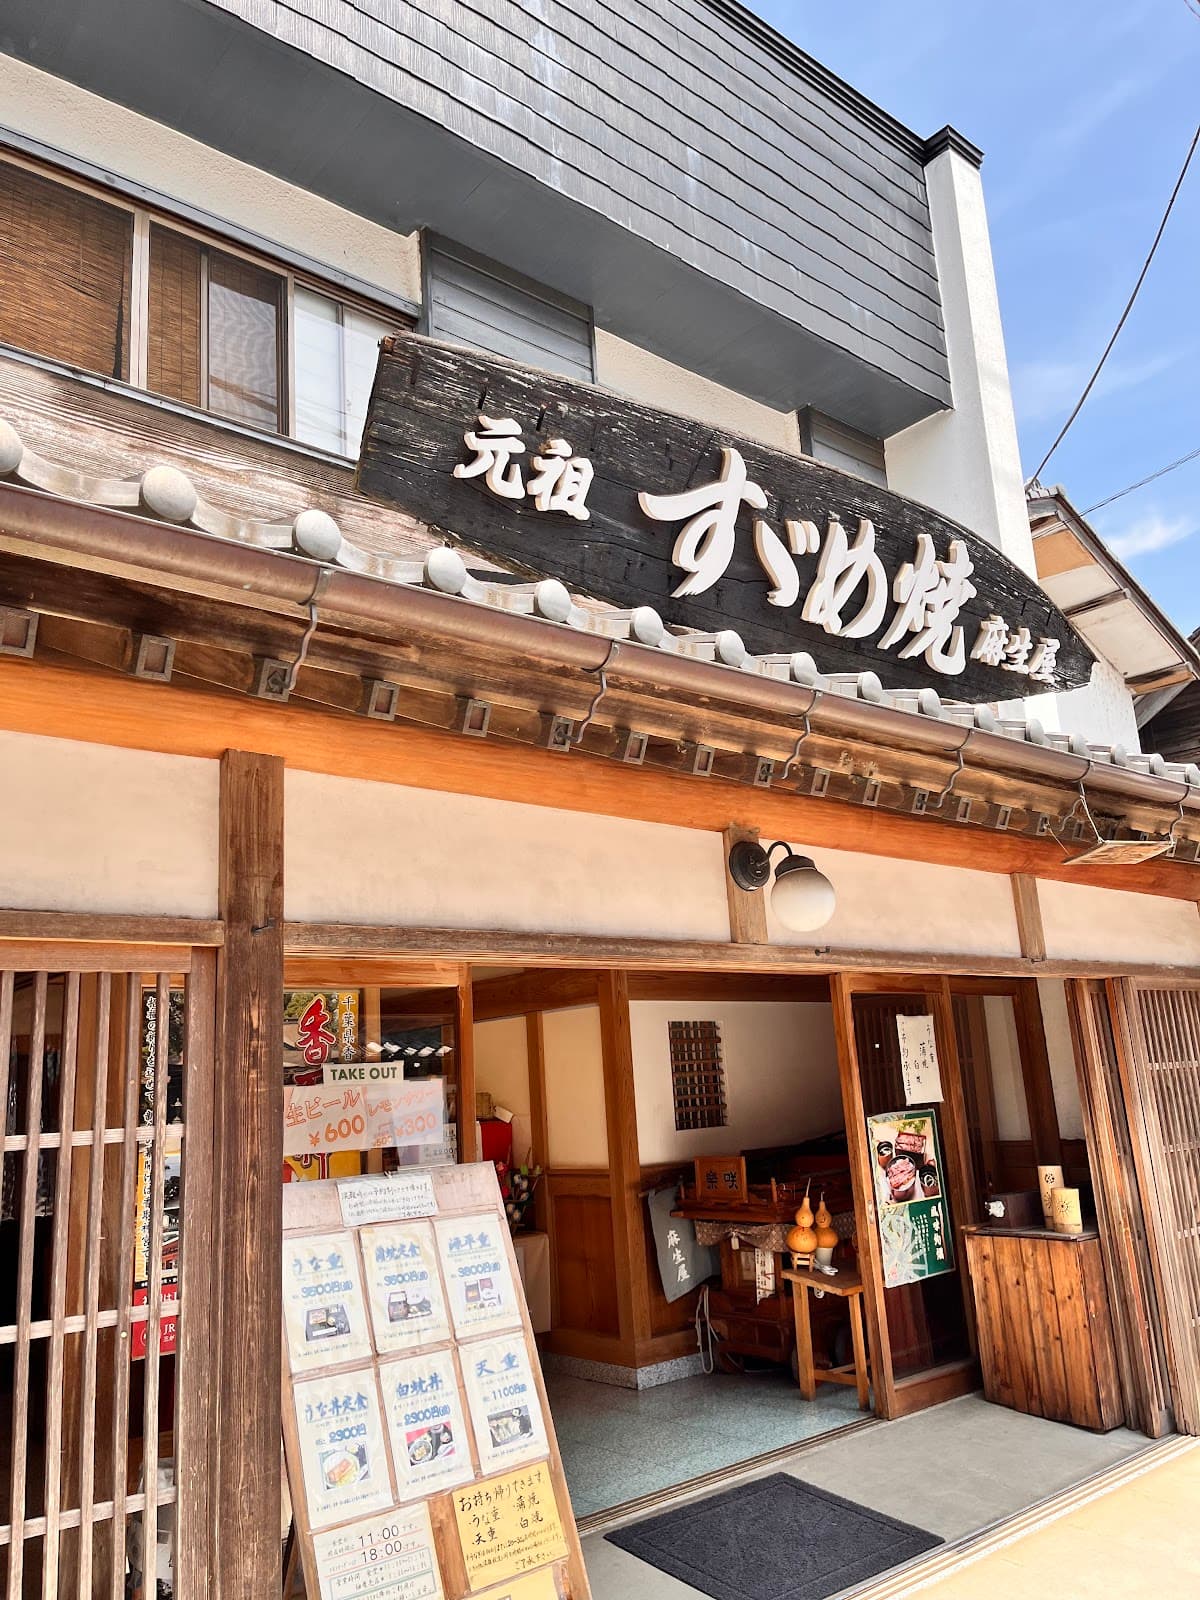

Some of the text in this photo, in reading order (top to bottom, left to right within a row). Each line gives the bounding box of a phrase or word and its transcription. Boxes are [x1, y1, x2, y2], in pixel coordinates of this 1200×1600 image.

[453, 415, 594, 521] 元祖
[970, 614, 1061, 684] 麻生屋
[330, 1068, 365, 1081] TAKE
[369, 1066, 398, 1080] OUT
[286, 1089, 361, 1128] 生ビール
[308, 1114, 366, 1147] ¥600
[666, 1229, 691, 1283] 麻生屋
[163, 1323, 175, 1336] JR
[358, 1524, 399, 1547] 11:00
[361, 1540, 402, 1563] 18:00
